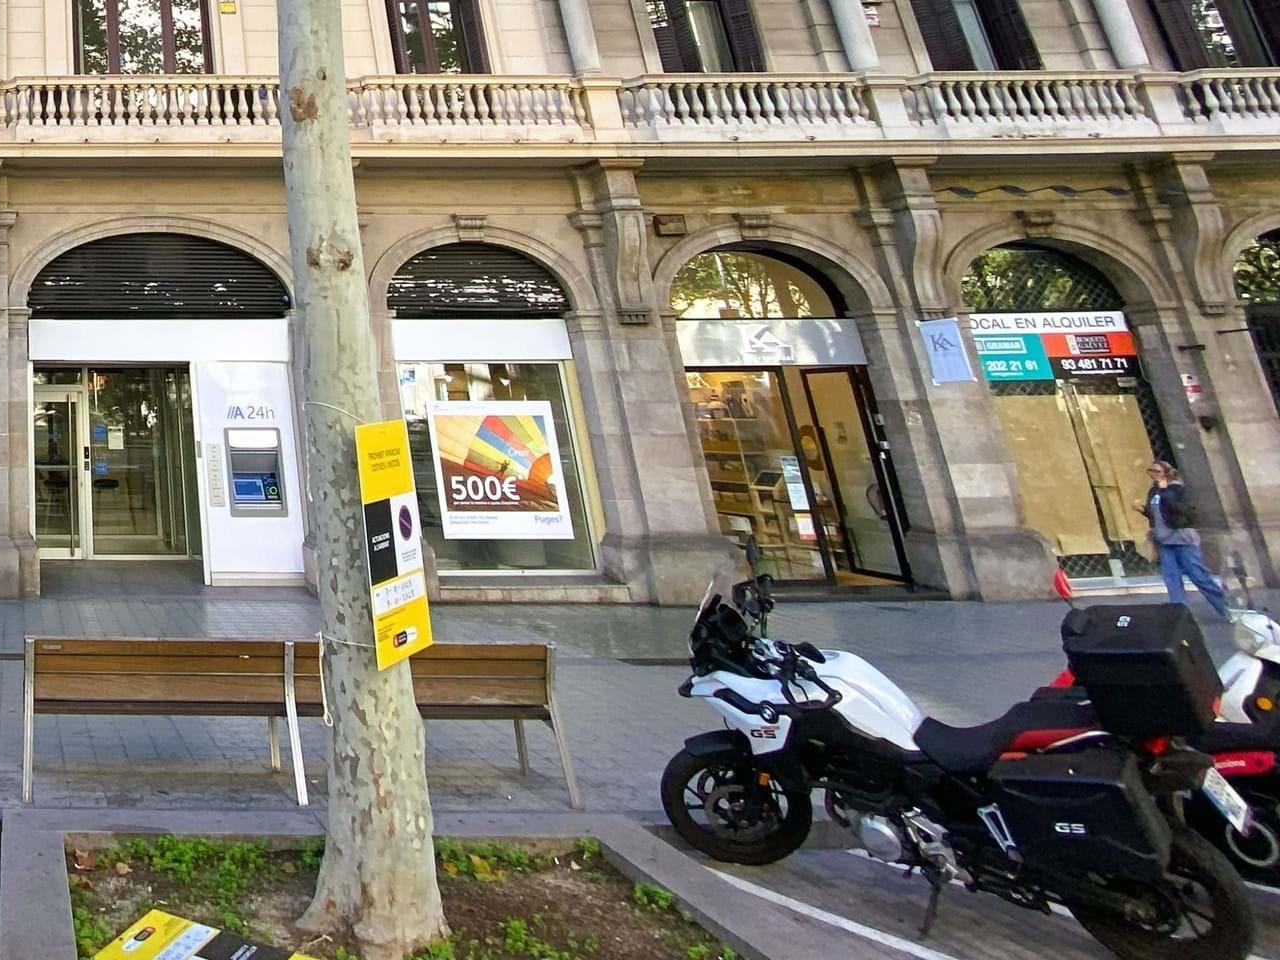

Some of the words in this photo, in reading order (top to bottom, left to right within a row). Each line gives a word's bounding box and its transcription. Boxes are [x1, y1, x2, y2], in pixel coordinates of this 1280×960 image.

[969, 317, 1012, 329] OCAL
[1015, 317, 1037, 328] EN
[1043, 316, 1116, 328] ALQUILER
[1061, 358, 1077, 370] 93
[1078, 358, 1098, 370] 481
[1098, 358, 1113, 369] 71
[1114, 357, 1129, 369] 71
[247, 405, 275, 420] 24h
[450, 475, 521, 501] 500€
[534, 515, 563, 526] Puges?
[750, 729, 777, 739] GS
[1054, 822, 1086, 834] GS
